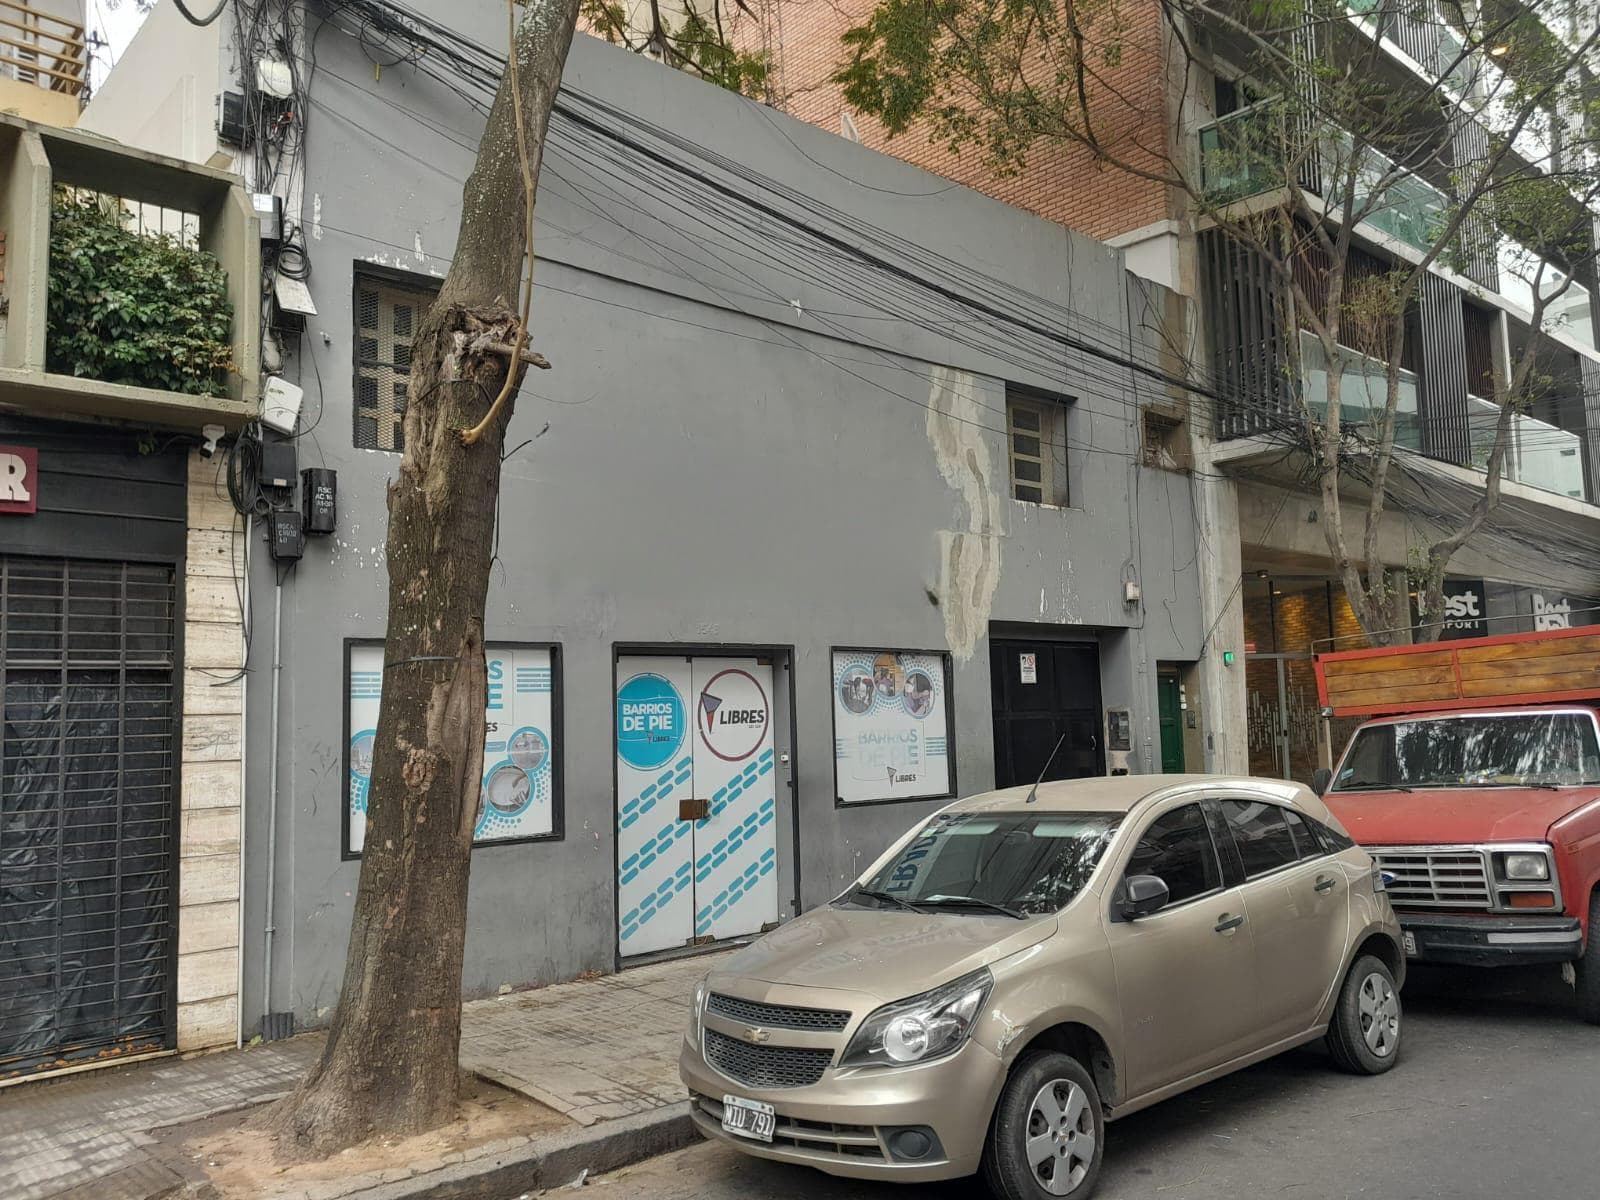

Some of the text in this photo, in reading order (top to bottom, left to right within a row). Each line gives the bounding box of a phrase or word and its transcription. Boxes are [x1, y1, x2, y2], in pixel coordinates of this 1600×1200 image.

[623, 702, 673, 715] BARRIOS
[623, 714, 673, 732] DE PIE
[719, 709, 764, 725] LIBRES
[895, 774, 917, 783] LIBRES
[750, 1110, 771, 1136] 791
